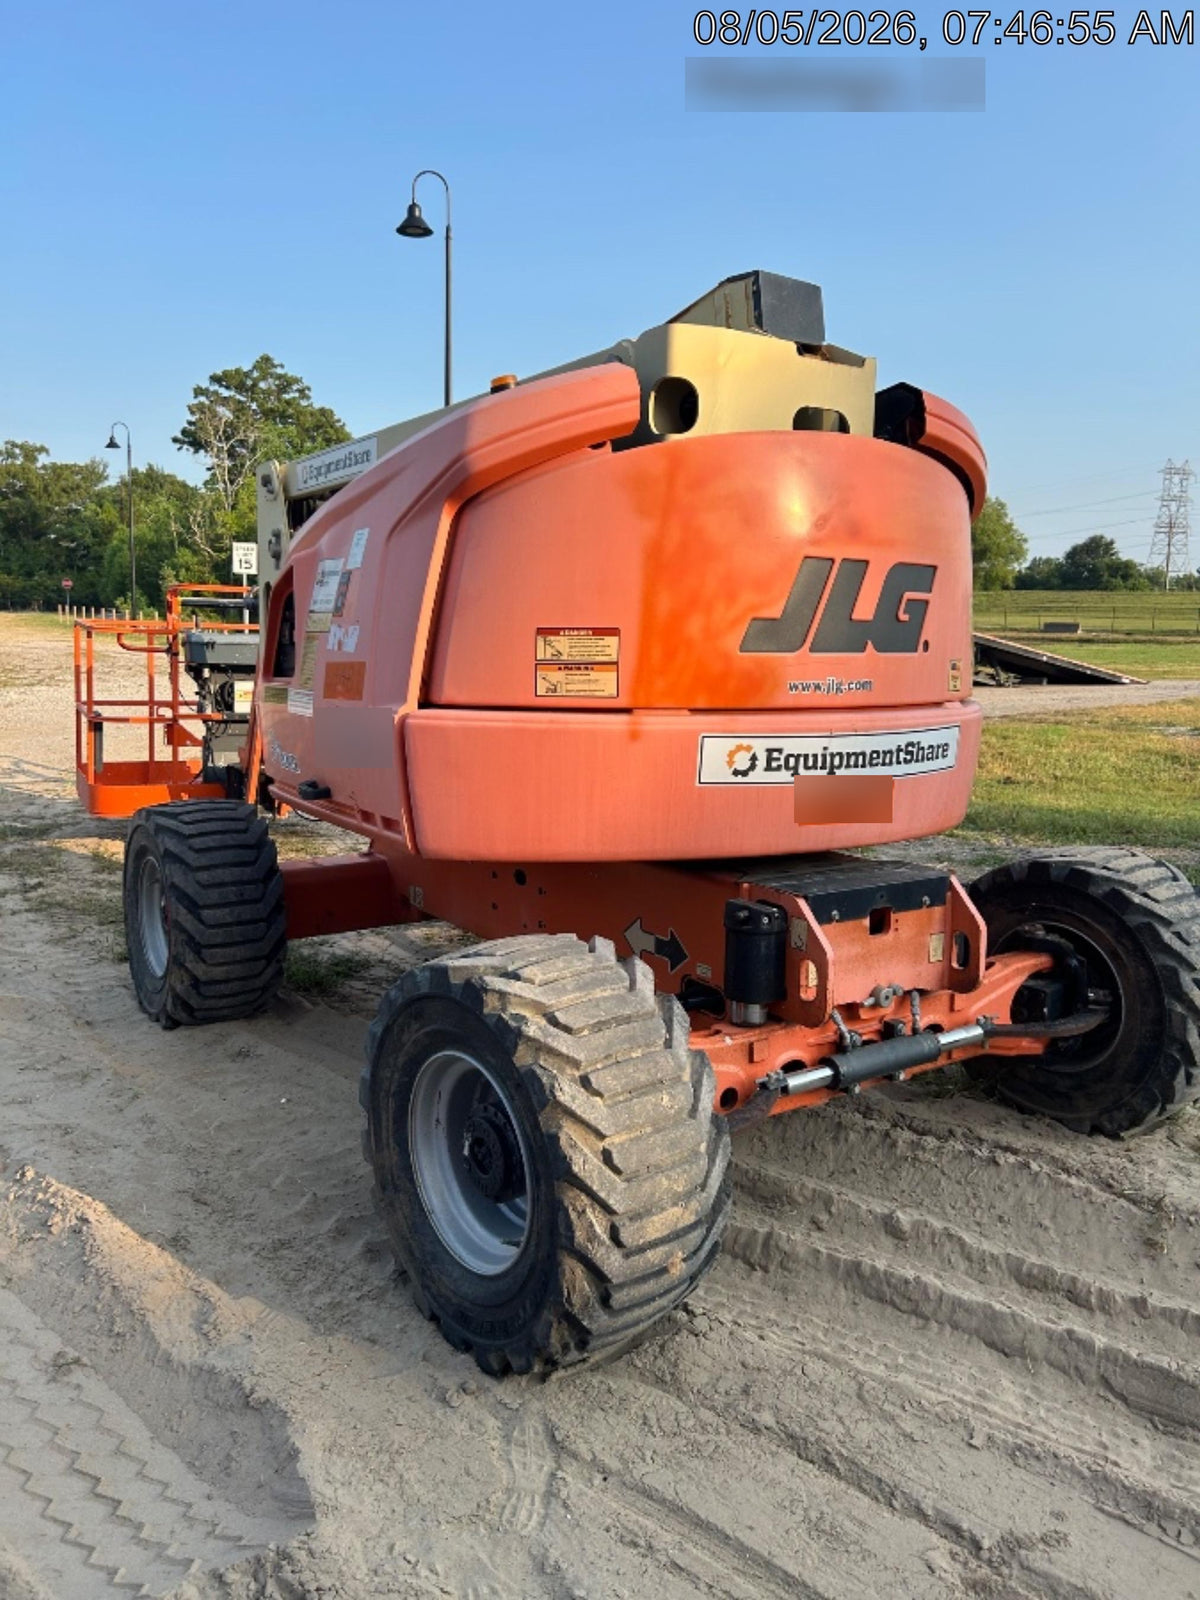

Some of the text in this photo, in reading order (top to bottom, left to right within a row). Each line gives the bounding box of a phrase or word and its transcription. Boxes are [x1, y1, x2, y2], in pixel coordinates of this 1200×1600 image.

[308, 449, 372, 480] EquipmentShare
[238, 558, 253, 569] 15
[739, 556, 937, 653] JLG
[788, 677, 873, 695] www.jlg.com
[763, 741, 950, 776] EquipmentShare
